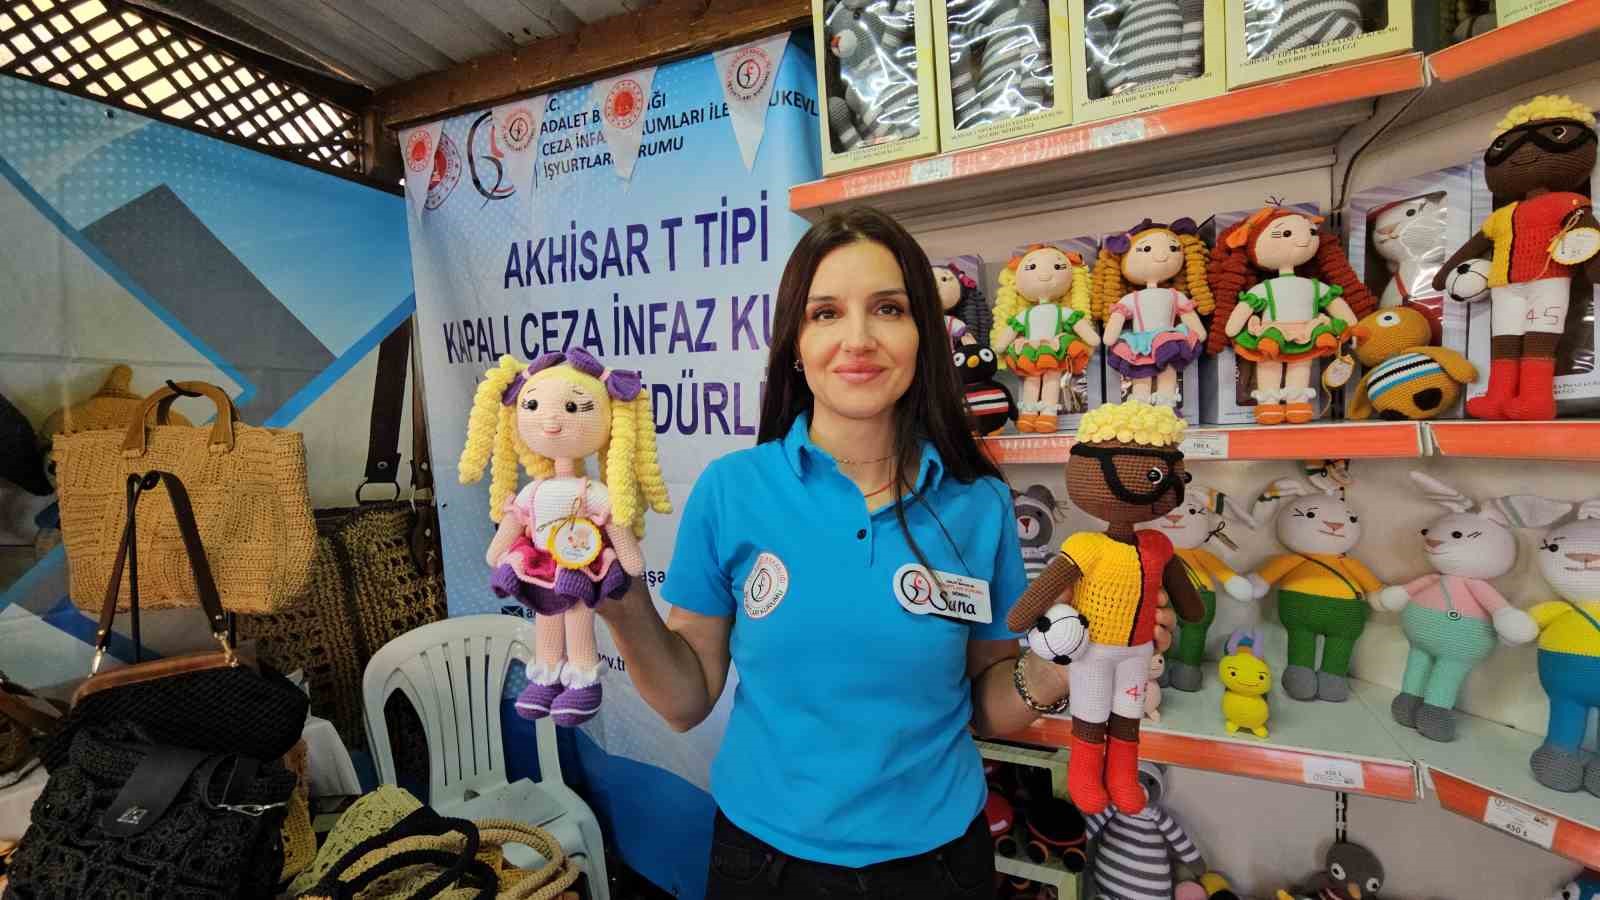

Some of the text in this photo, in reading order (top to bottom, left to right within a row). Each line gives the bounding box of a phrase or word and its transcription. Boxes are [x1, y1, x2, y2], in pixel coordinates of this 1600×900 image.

[545, 98, 560, 113] .C.
[540, 112, 588, 136] ADALET
[542, 90, 818, 156] CEZA İNFA UMLARI İLE UKEVL
[638, 136, 684, 158] RUMU
[504, 190, 768, 289] AKHİSAR T TİPİ
[443, 292, 771, 364] KAPALI CEZA İNFAZ KU
[1526, 305, 1561, 325] 45
[642, 369, 764, 436] DÜRL
[929, 590, 976, 616] Suna
